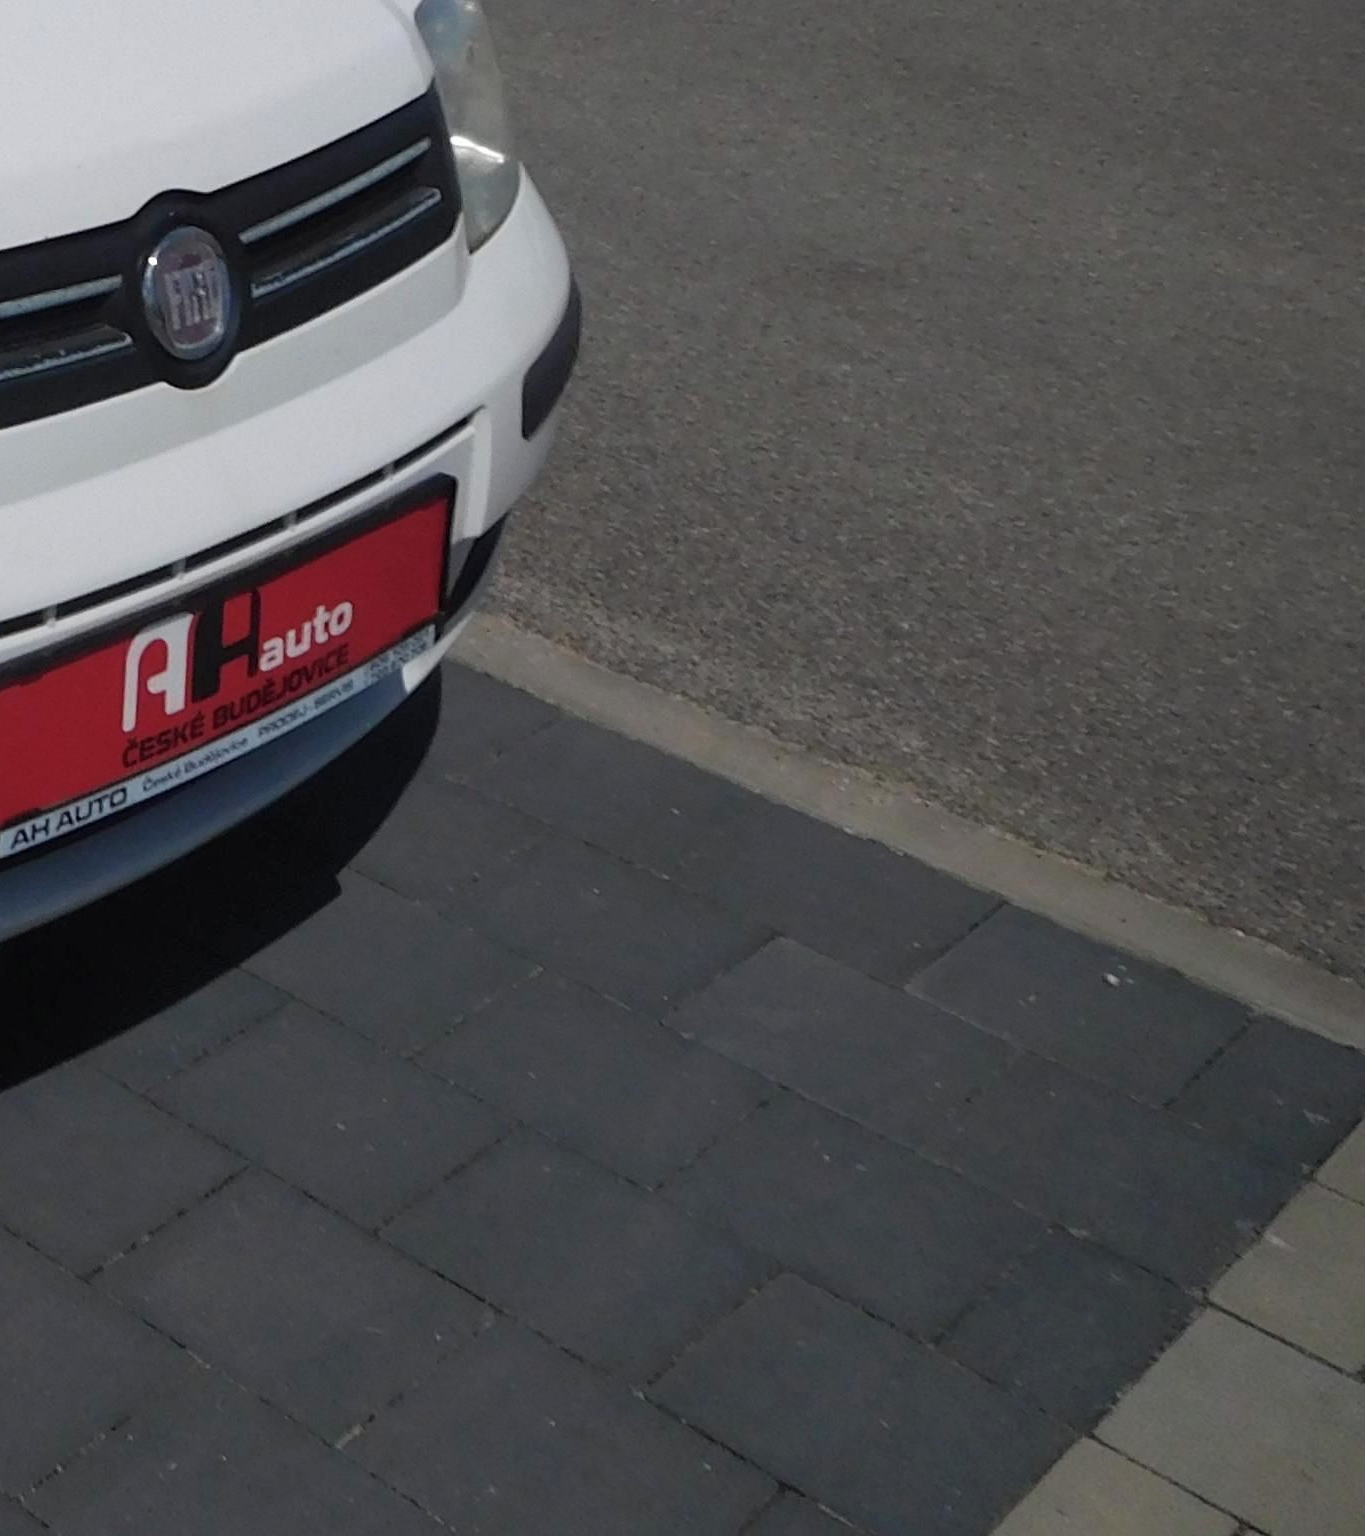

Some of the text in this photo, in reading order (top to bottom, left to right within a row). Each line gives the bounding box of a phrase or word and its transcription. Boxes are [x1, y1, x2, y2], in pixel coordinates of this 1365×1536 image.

[259, 601, 354, 672] auto
[121, 710, 206, 769] ČESKÉ
[212, 643, 350, 730] BUDĚJOVICE
[10, 817, 50, 851] AH
[56, 786, 129, 832] AUTO
